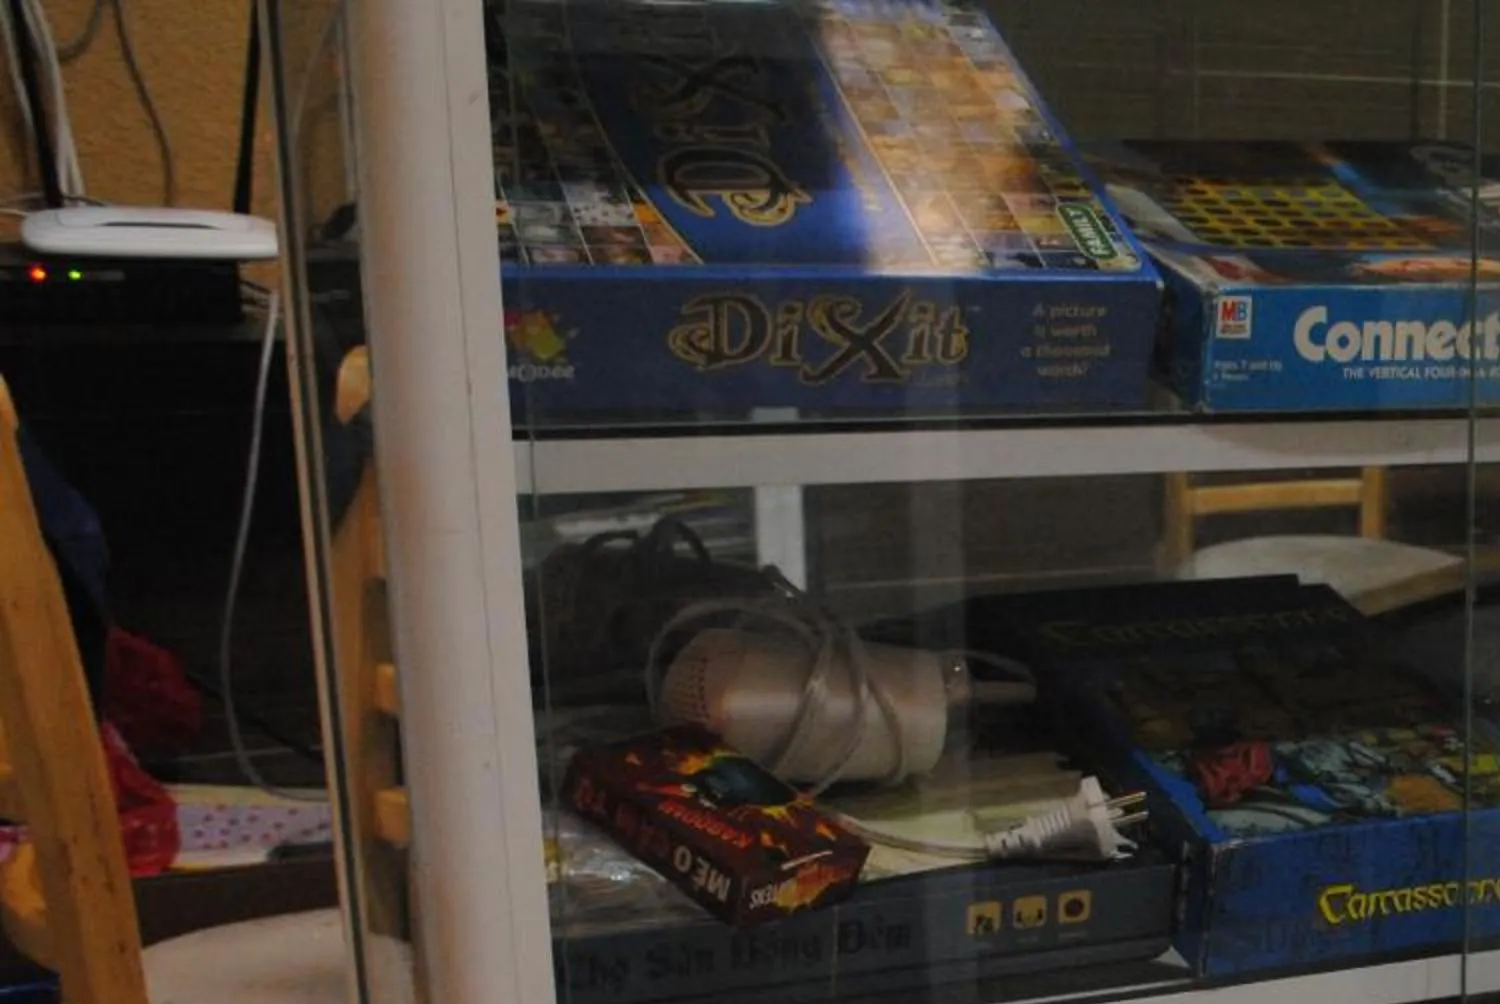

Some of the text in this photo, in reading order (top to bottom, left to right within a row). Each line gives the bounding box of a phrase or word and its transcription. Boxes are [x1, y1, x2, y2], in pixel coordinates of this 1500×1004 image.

[1222, 300, 1247, 321] MB
[667, 289, 968, 387] DiXit
[1294, 304, 1499, 362] Connect
[1343, 366, 1364, 379] THE
[1369, 366, 1421, 380] VERTICAL
